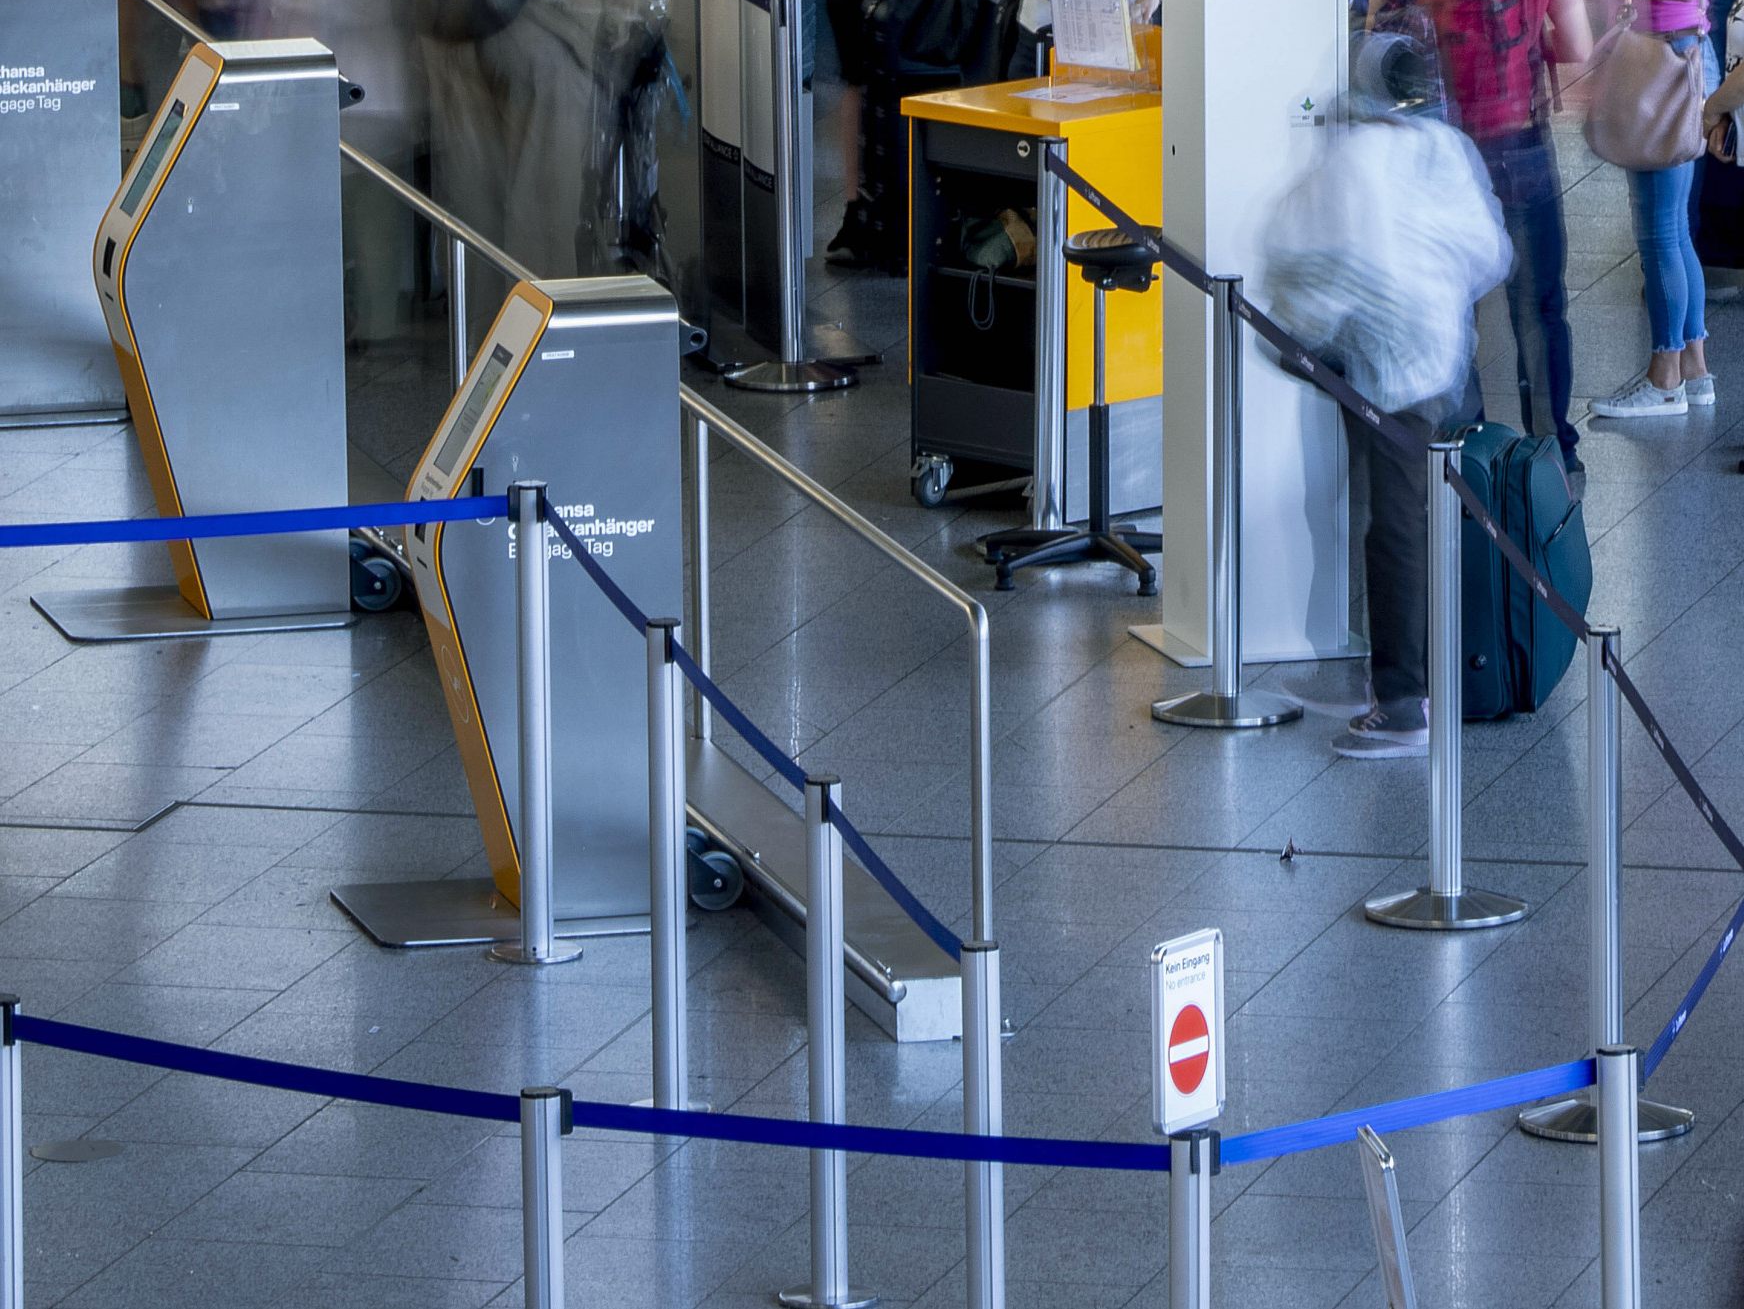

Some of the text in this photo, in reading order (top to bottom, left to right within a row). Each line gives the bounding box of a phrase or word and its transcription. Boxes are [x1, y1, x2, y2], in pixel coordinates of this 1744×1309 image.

[36, 94, 62, 112] Tag
[583, 538, 614, 557] Tag
[1166, 952, 1210, 975] Kein Eingang
[1177, 971, 1206, 989] entrance
